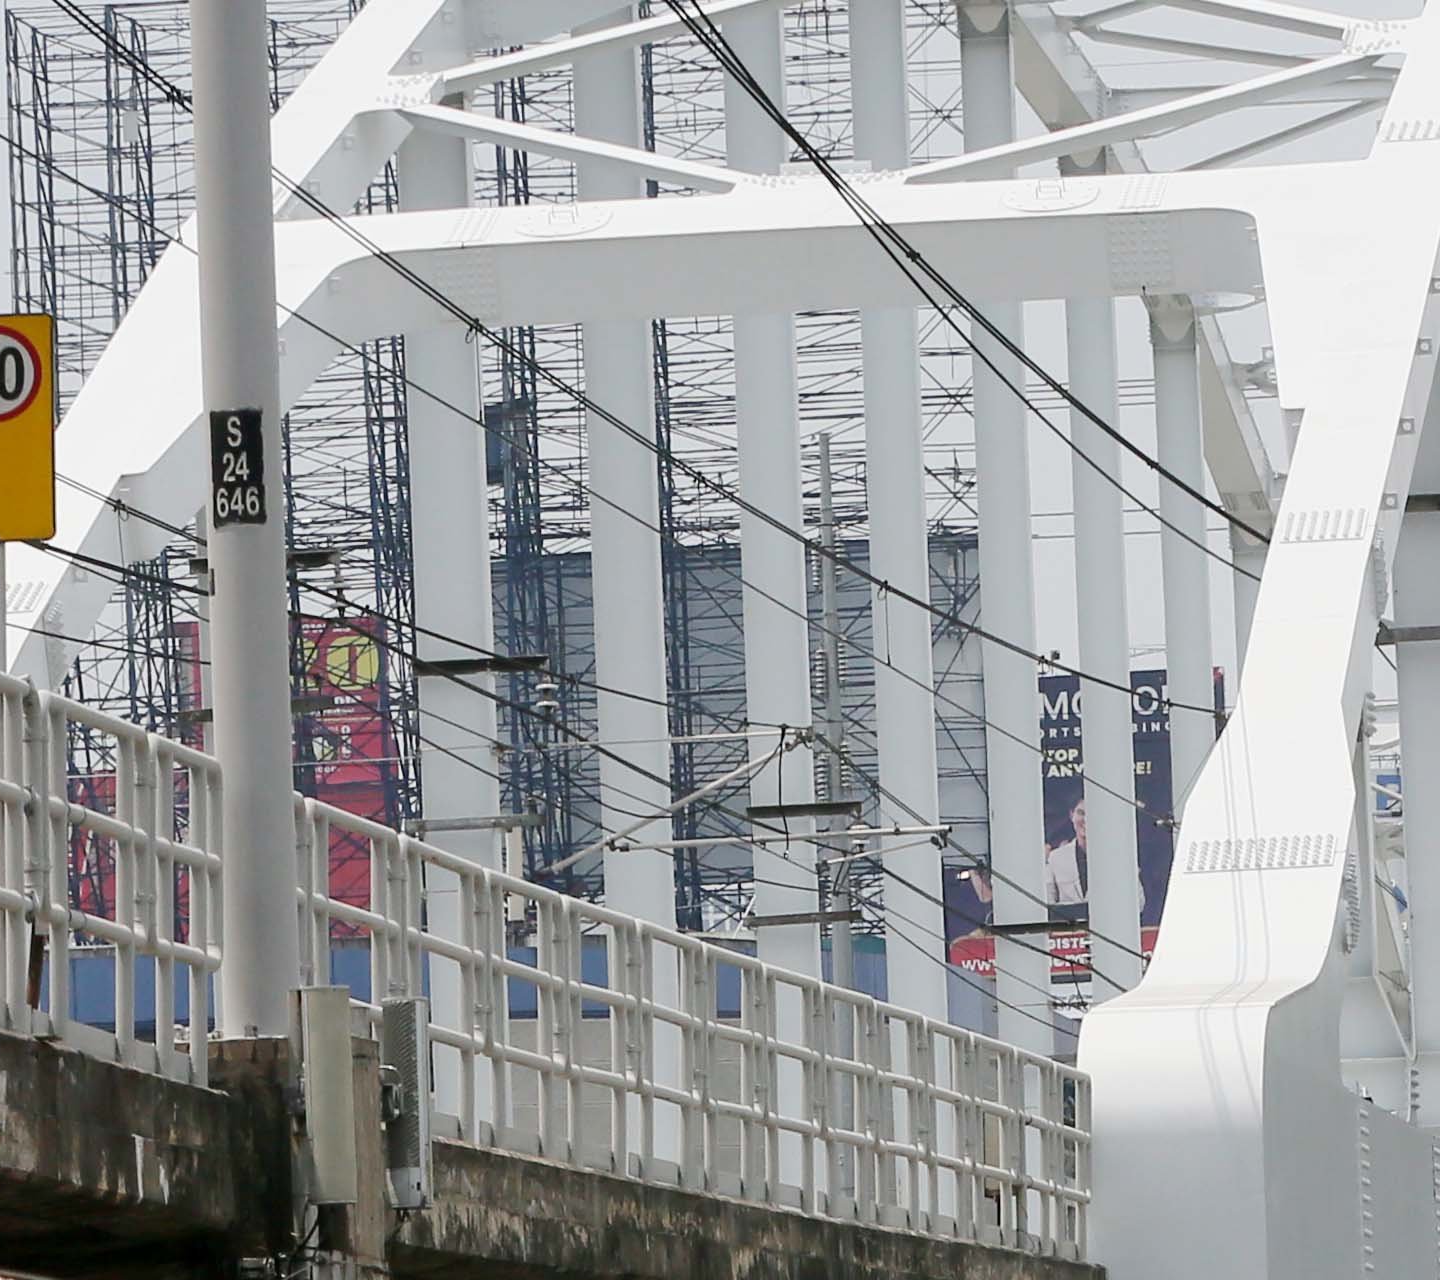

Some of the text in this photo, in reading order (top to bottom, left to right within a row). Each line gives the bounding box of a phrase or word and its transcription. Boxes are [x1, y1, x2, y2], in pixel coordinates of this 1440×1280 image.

[227, 416, 241, 447] S
[222, 452, 249, 482] 24
[216, 487, 260, 518] 646
